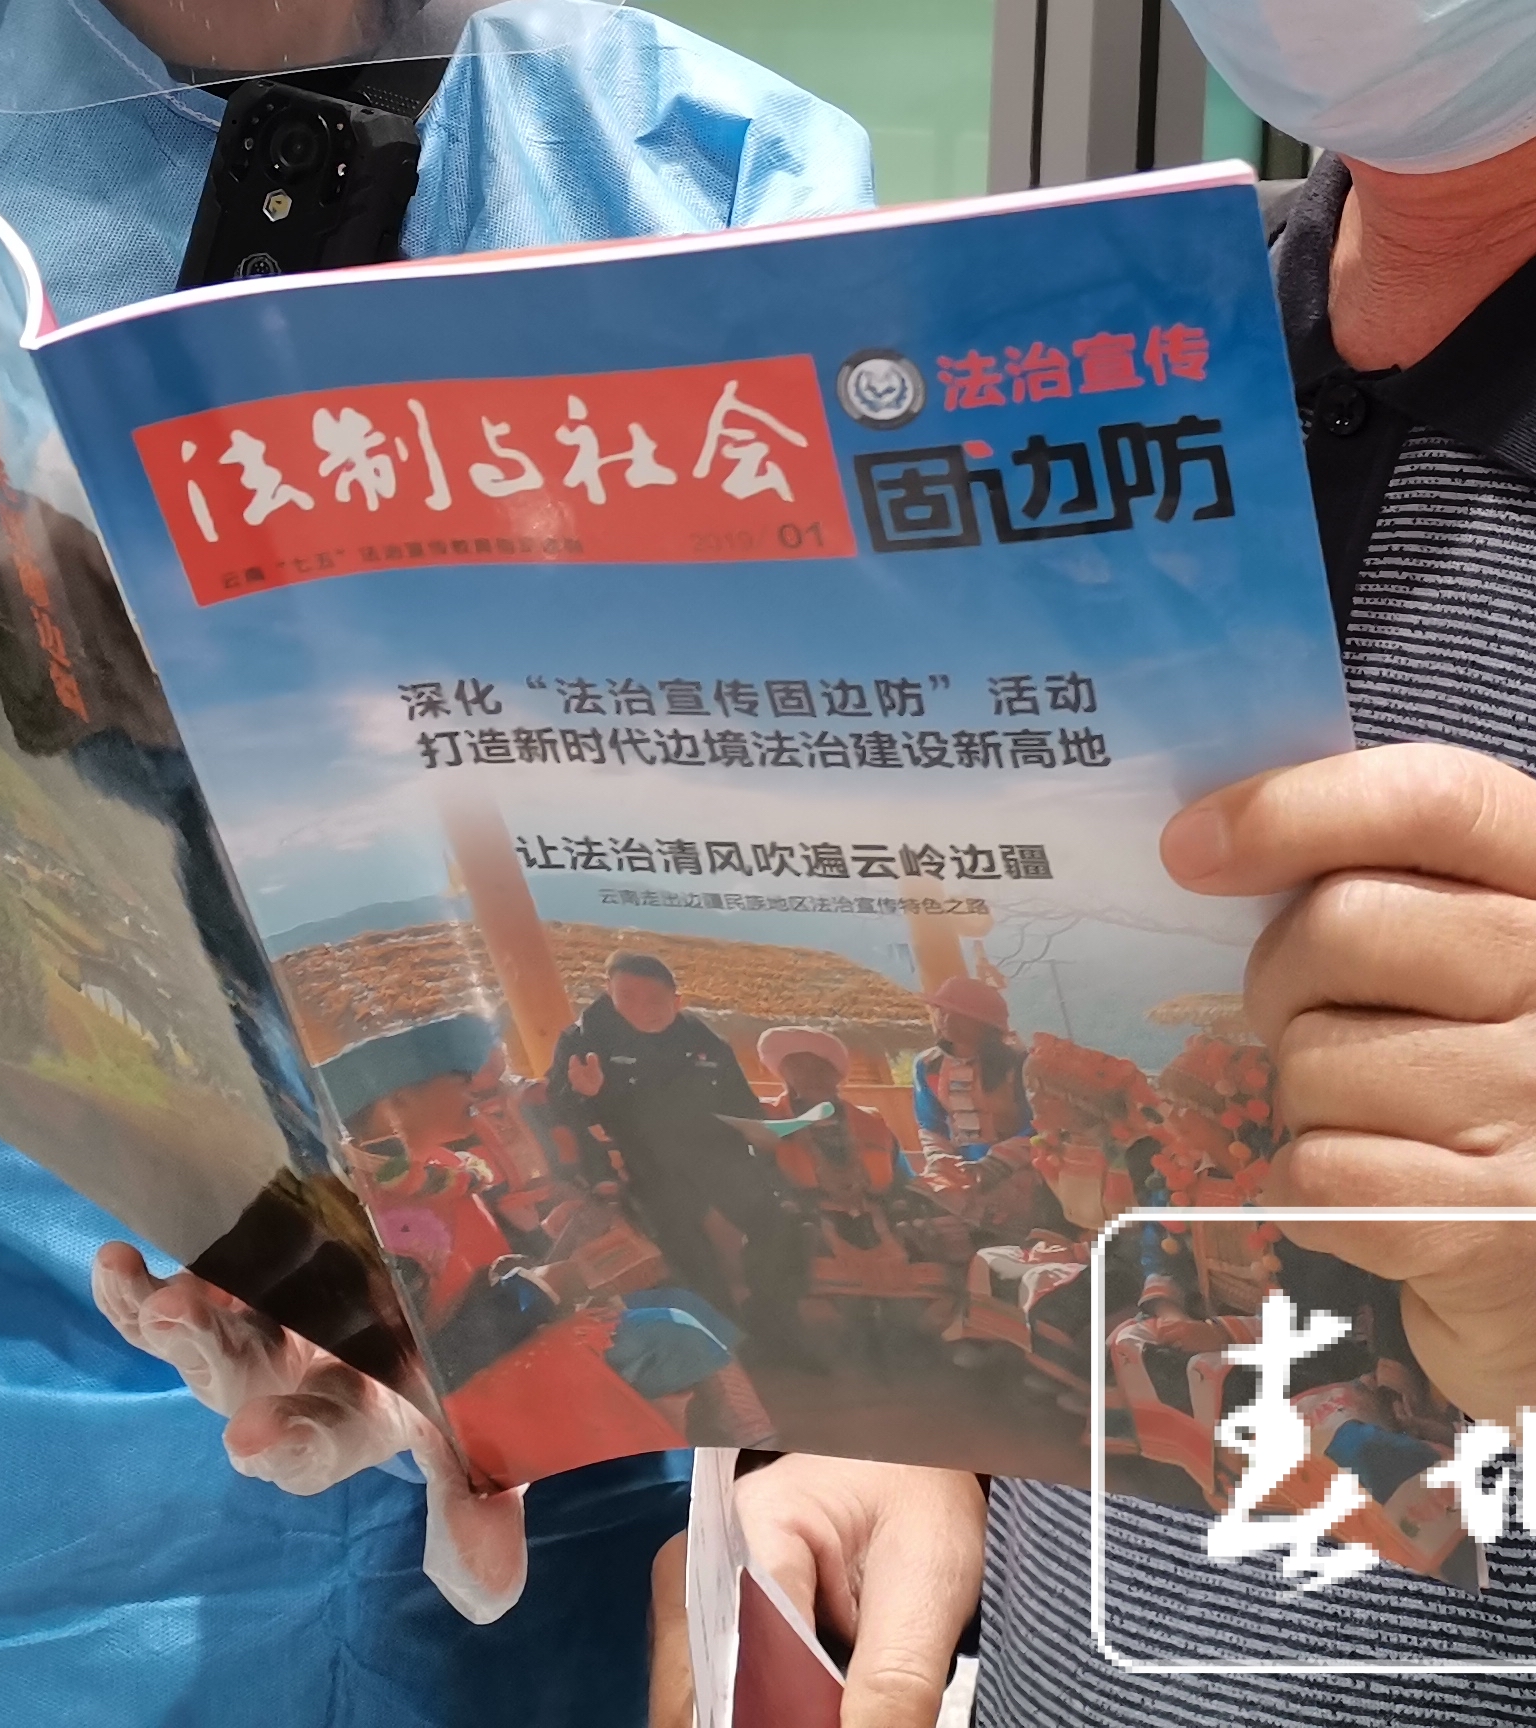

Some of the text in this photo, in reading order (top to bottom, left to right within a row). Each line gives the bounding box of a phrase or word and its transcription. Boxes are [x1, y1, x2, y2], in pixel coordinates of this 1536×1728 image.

[937, 323, 1211, 412] 法治宣传
[181, 380, 808, 543] 法制与社会
[854, 415, 1236, 553] 固边防
[417, 727, 1111, 770] 打造新时代边境法治建设新高地
[515, 835, 1053, 880] 让法治清风吹遍云岭边疆
